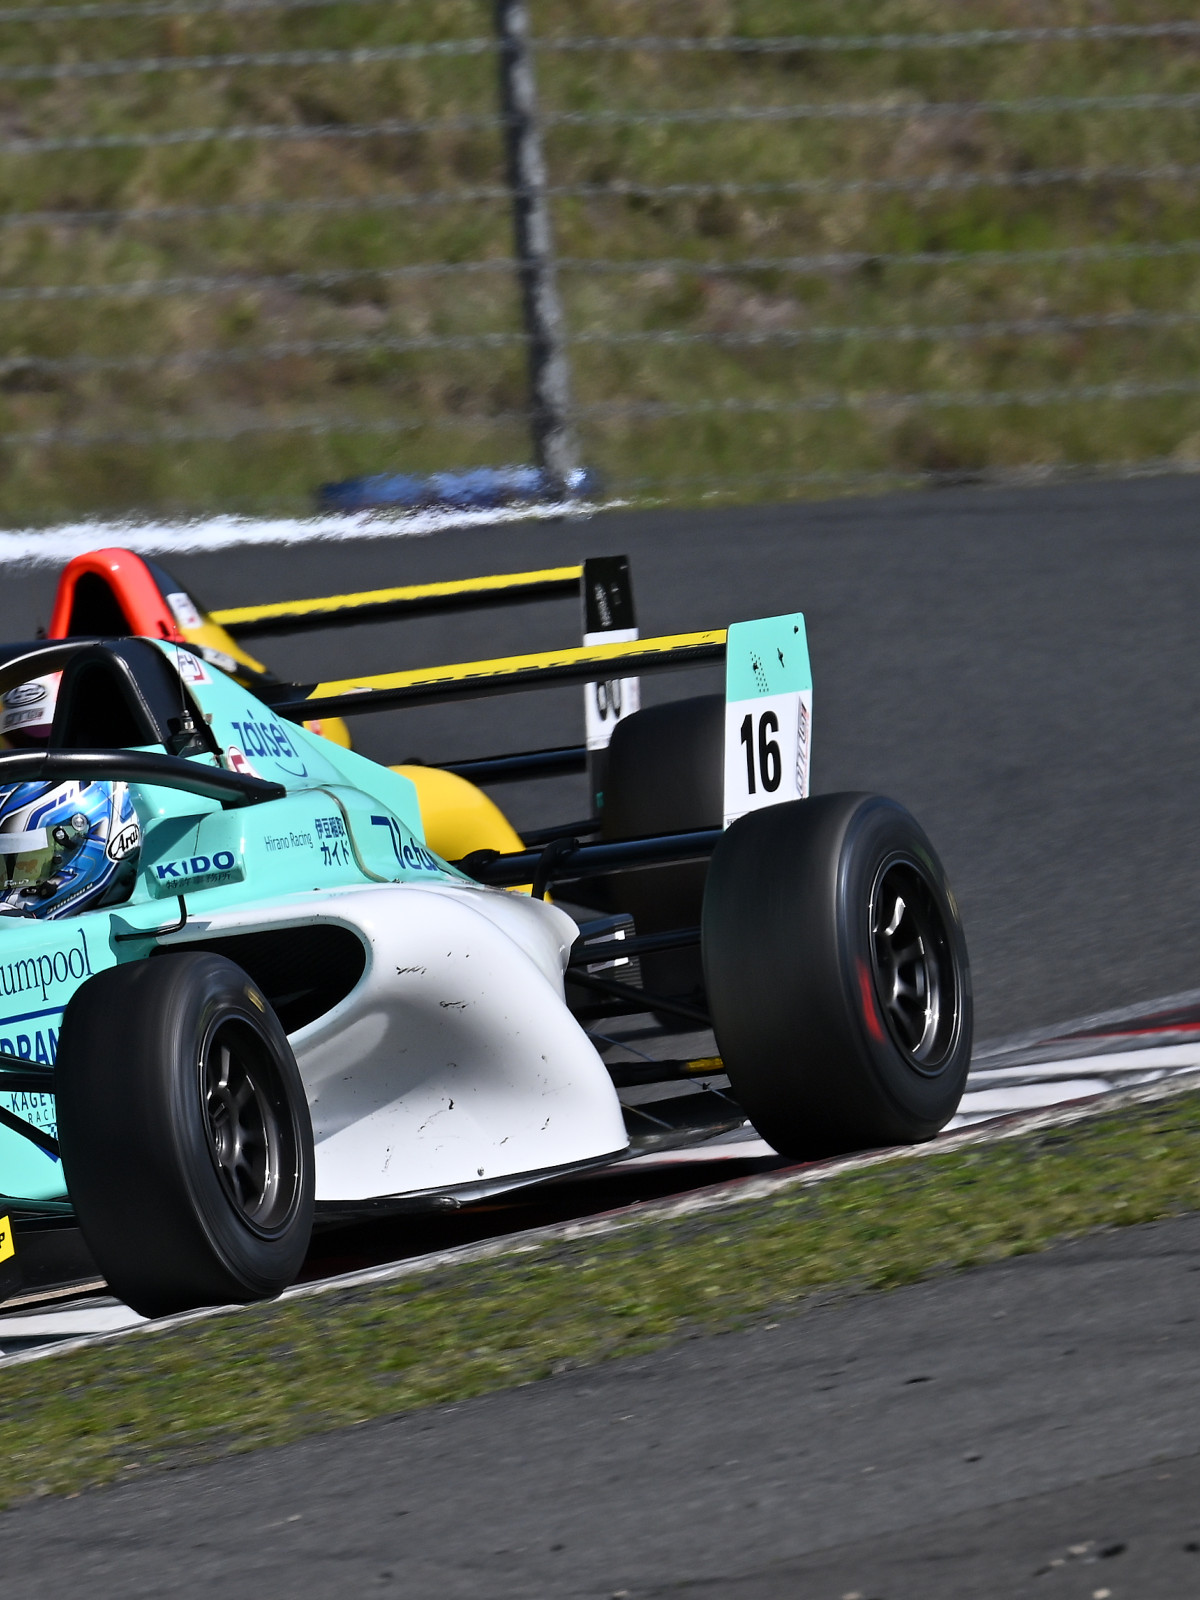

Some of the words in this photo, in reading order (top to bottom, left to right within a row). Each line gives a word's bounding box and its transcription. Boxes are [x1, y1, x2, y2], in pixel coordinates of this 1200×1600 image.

[740, 710, 782, 795] 16
[112, 826, 139, 857] Arai
[264, 835, 290, 851] Hirano
[289, 832, 314, 848] Racing
[156, 851, 235, 879] KIDO
